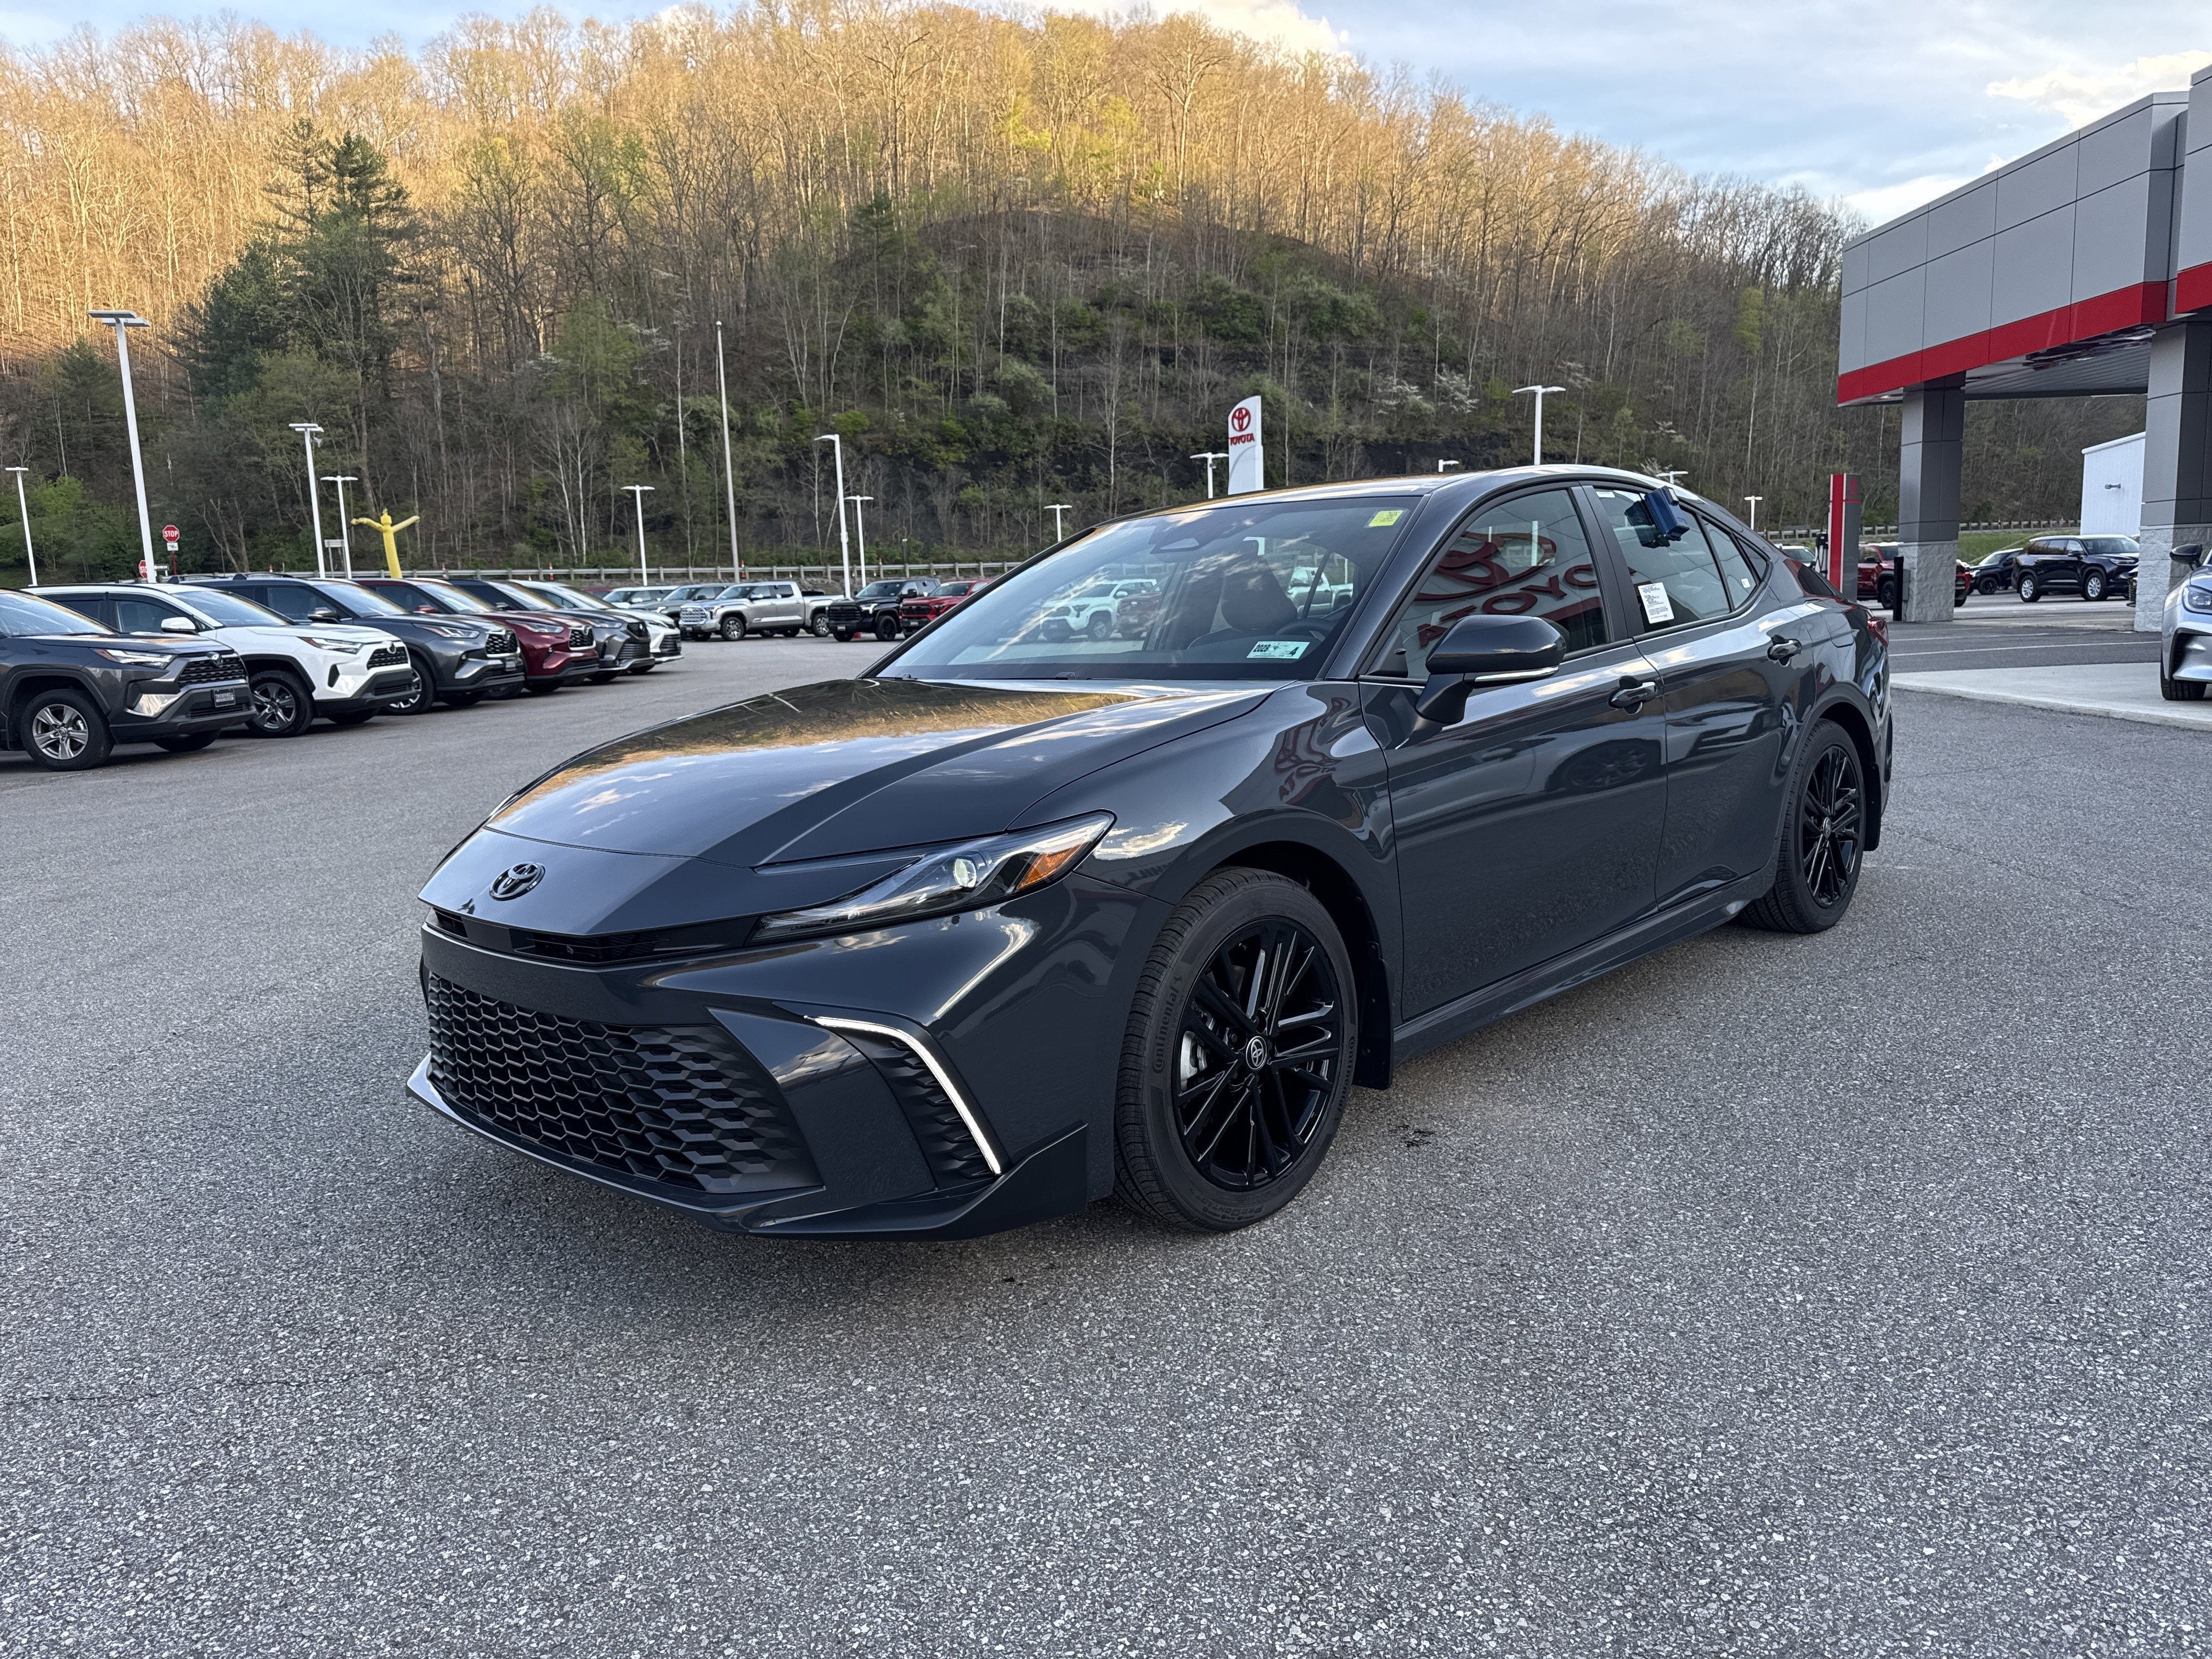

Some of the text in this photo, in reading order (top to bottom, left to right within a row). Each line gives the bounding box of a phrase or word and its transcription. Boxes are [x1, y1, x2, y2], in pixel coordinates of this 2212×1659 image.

[1229, 433, 1255, 445] TOYOTA
[1289, 647, 1299, 656] 4
[1153, 986, 1179, 1074] Continental
